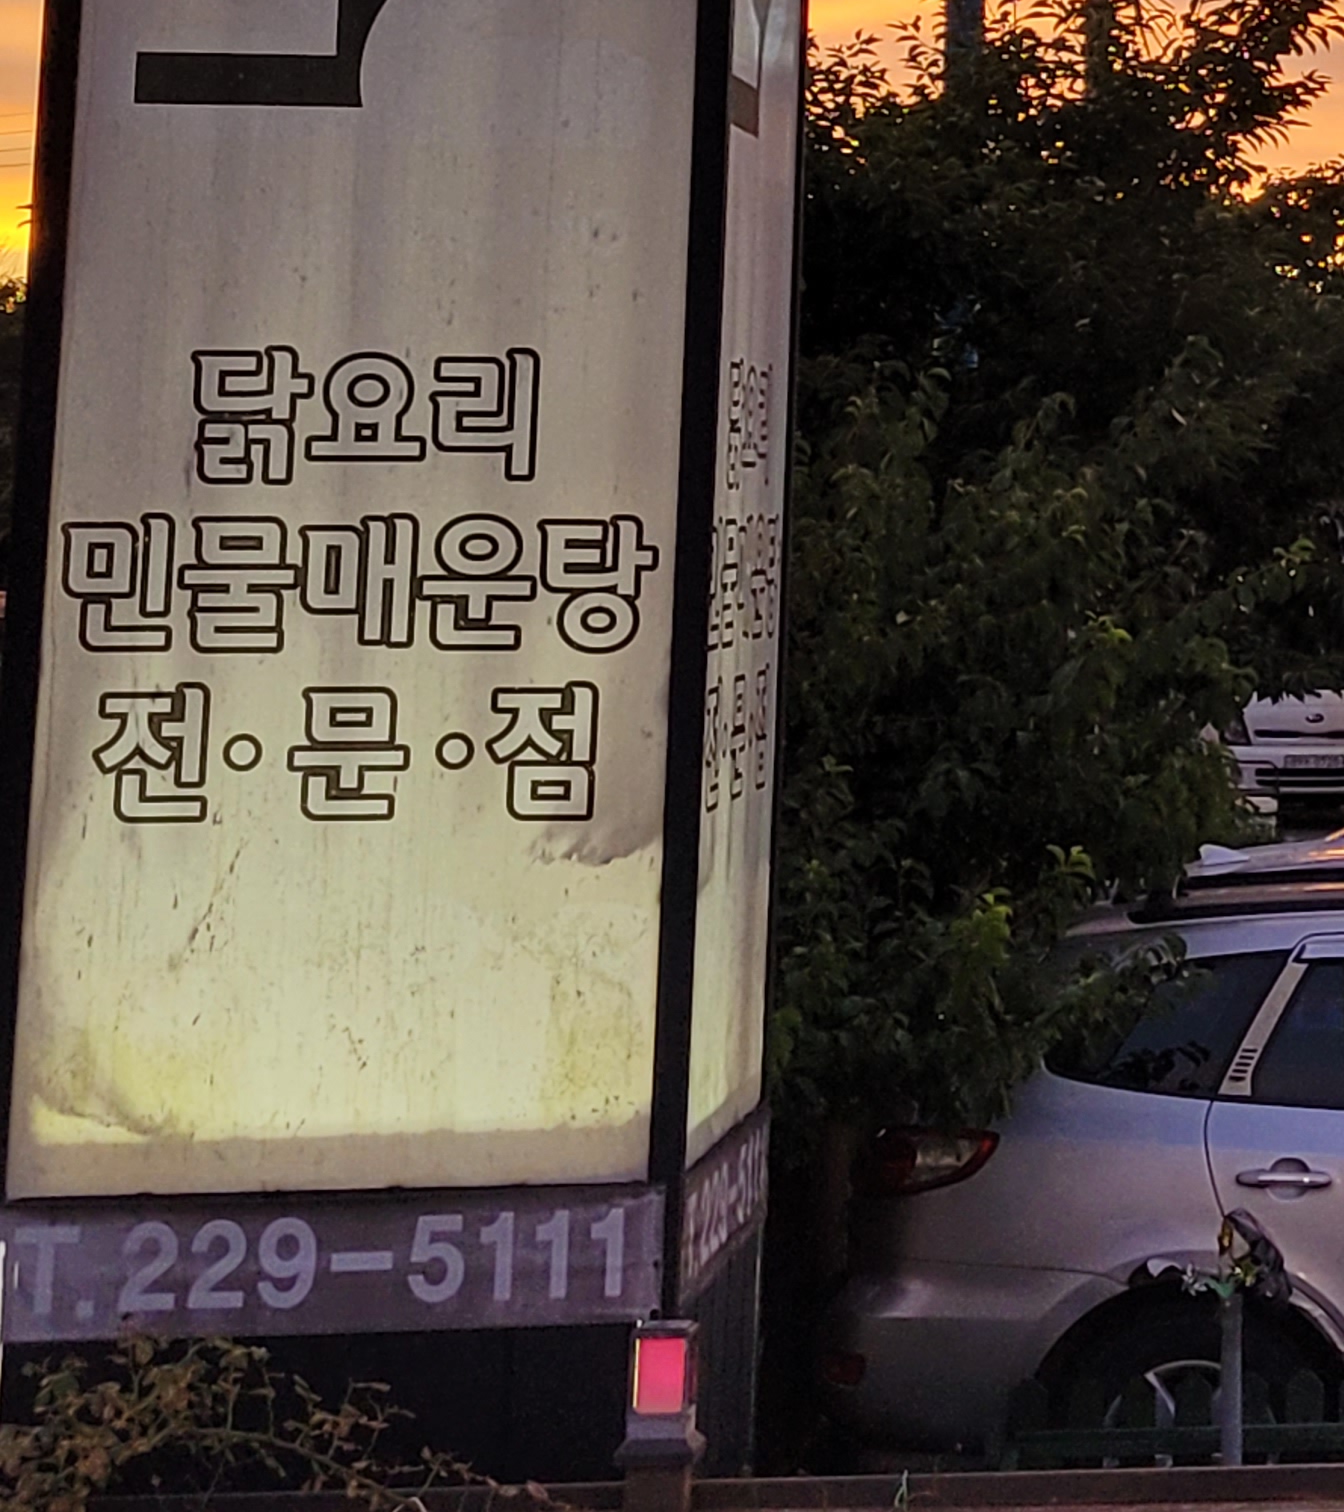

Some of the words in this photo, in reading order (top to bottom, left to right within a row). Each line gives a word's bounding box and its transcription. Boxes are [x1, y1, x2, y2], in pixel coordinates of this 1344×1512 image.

[191, 346, 540, 486] 닭요리
[61, 512, 660, 653] 민물매운탕
[13, 1206, 627, 1319] T.229-5111
